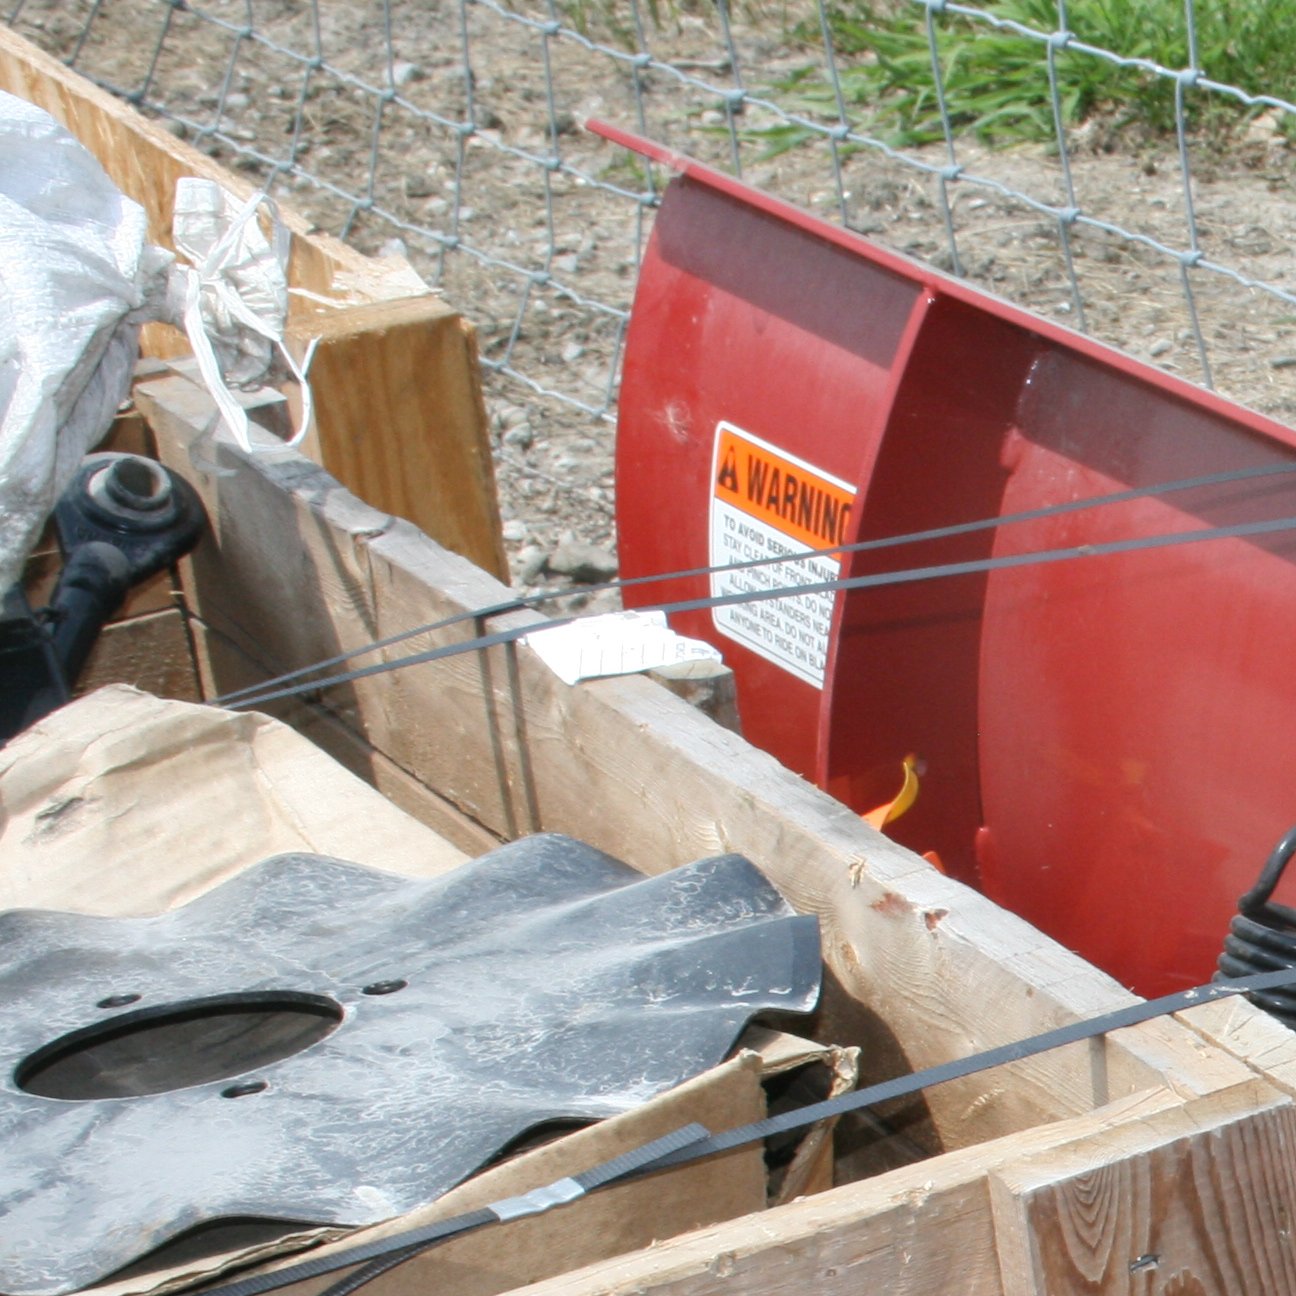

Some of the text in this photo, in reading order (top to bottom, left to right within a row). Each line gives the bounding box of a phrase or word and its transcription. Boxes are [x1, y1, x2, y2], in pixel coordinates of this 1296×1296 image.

[723, 514, 736, 530] TO
[738, 523, 765, 546] AVOID
[723, 533, 742, 549] STAY
[785, 622, 797, 639] DO
